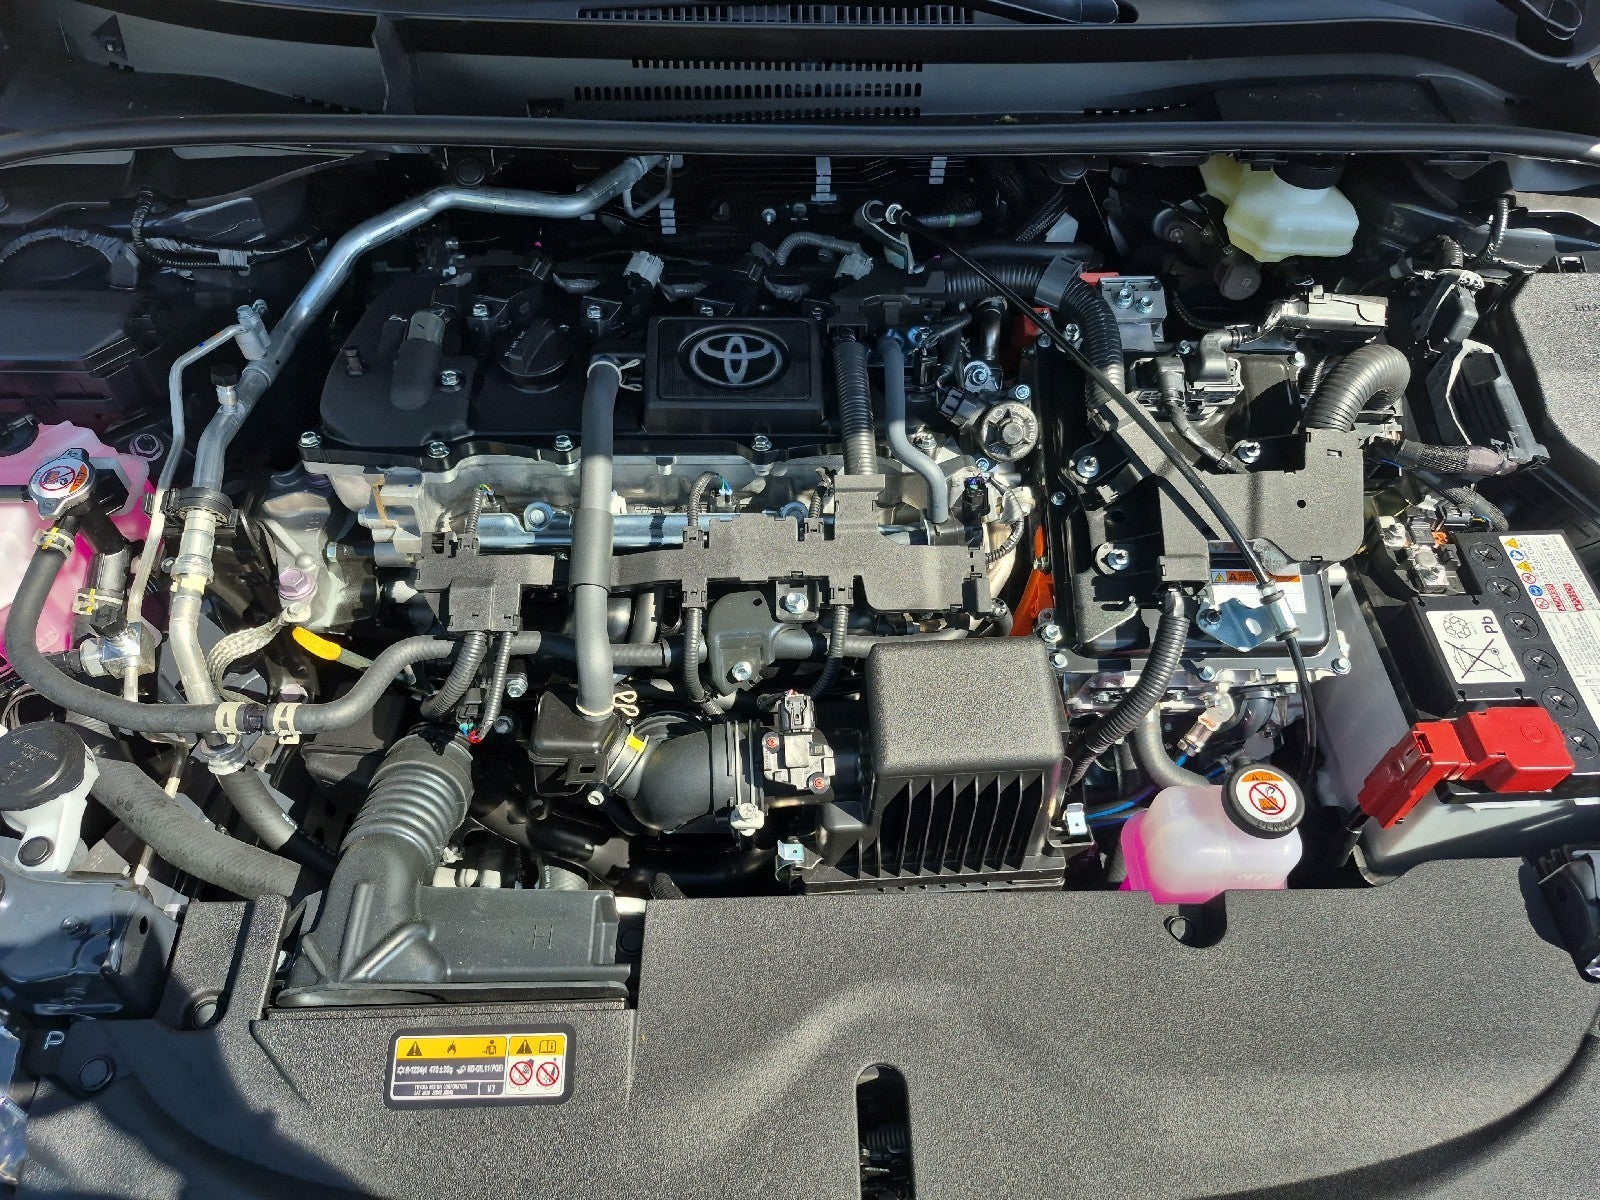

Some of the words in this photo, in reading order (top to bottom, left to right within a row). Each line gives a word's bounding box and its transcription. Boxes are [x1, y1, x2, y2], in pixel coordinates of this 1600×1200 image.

[1481, 616, 1499, 634] Pb
[1256, 821, 1291, 831] DENSO
[487, 1084, 496, 1093] V7
